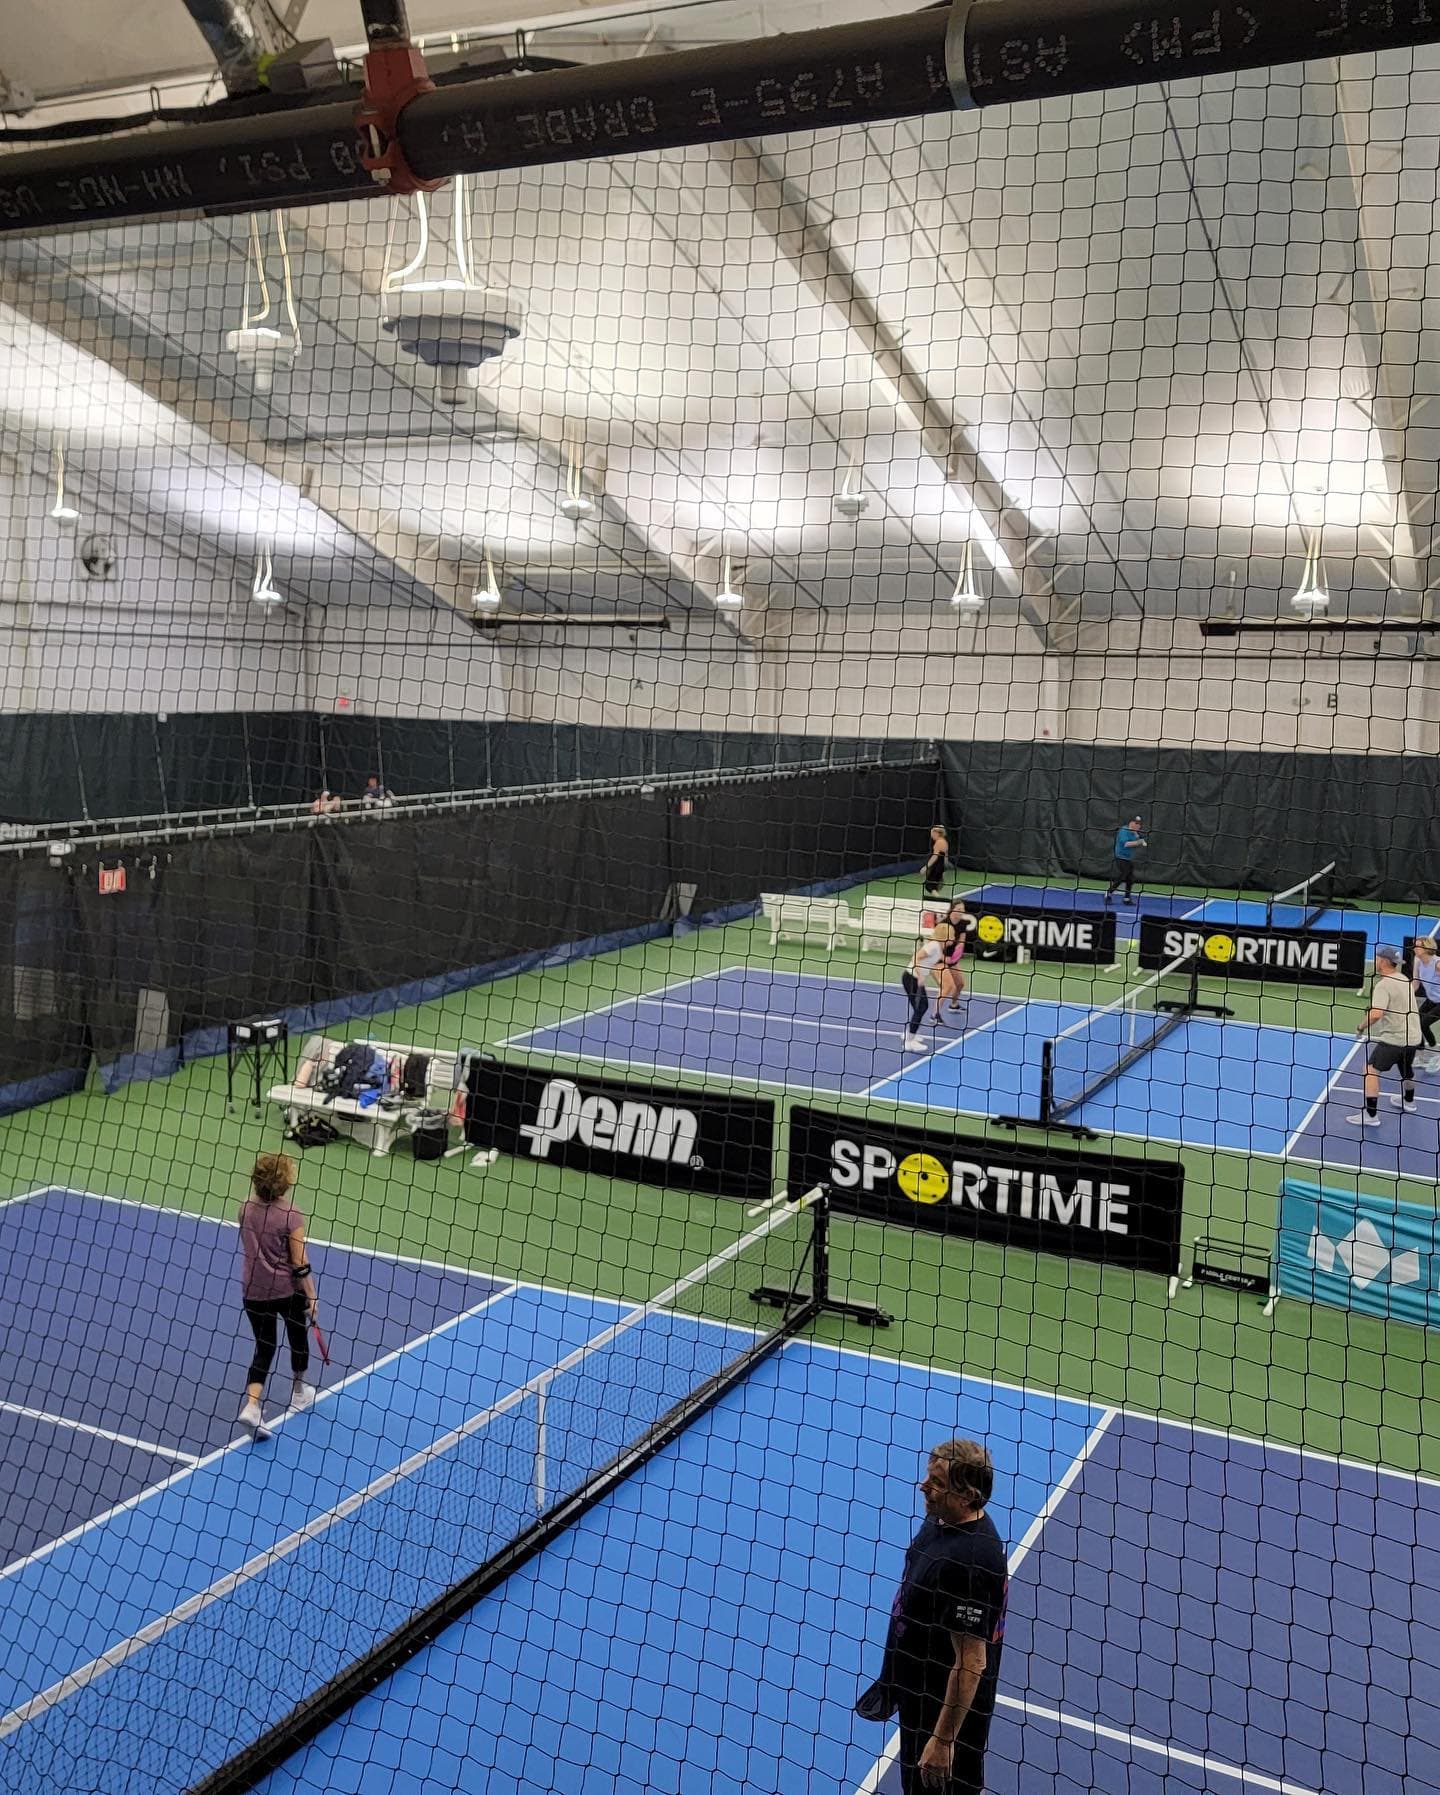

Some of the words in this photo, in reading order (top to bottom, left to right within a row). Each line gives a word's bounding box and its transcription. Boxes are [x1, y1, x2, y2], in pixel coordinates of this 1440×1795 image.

[515, 96, 657, 149] GRADE
[1163, 929, 1339, 971] SPORTIME
[830, 1138, 1131, 1235] SPORTIME
